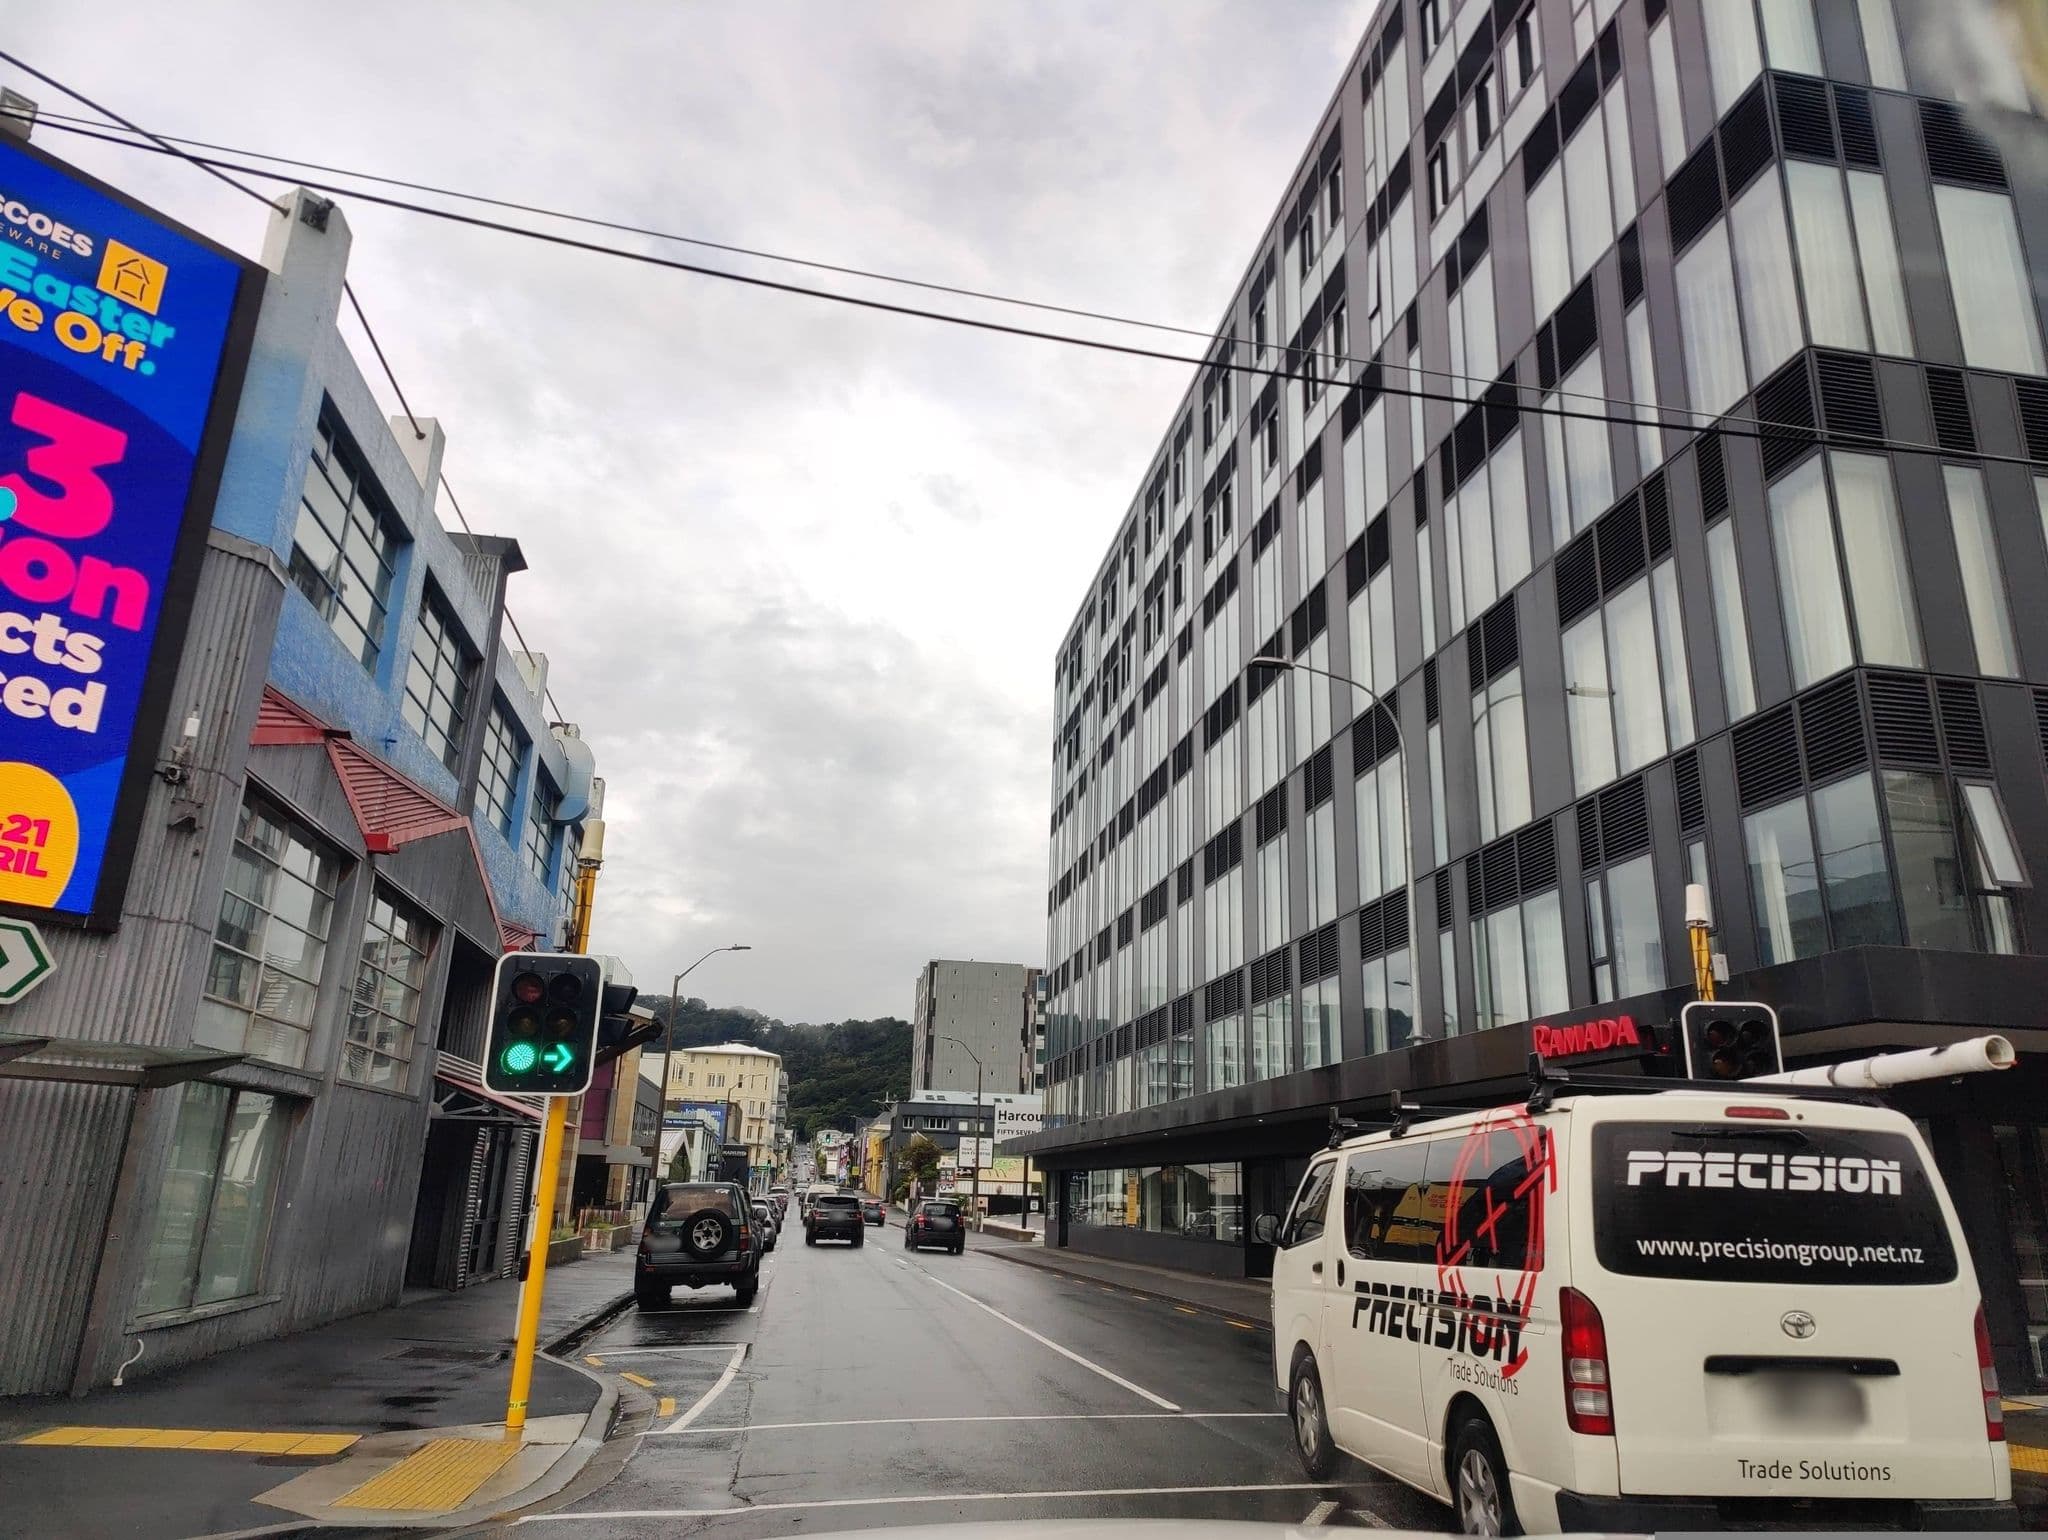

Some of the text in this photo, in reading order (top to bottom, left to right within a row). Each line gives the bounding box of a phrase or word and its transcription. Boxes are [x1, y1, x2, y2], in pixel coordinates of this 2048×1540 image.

[0, 194, 94, 257] COES
[0, 526, 149, 632] on
[0, 671, 107, 733] ed
[1533, 1015, 1640, 1057] RAMADA
[997, 1128, 1014, 1136] FIFTY
[1627, 1150, 1902, 1195] PRECISION
[1637, 1237, 1925, 1267] www.precisiongroup.net.nz
[1352, 1280, 1521, 1366] PRECISION
[1447, 1357, 1519, 1396] Trade Solutions
[1737, 1459, 1891, 1481] Trade Solutions
